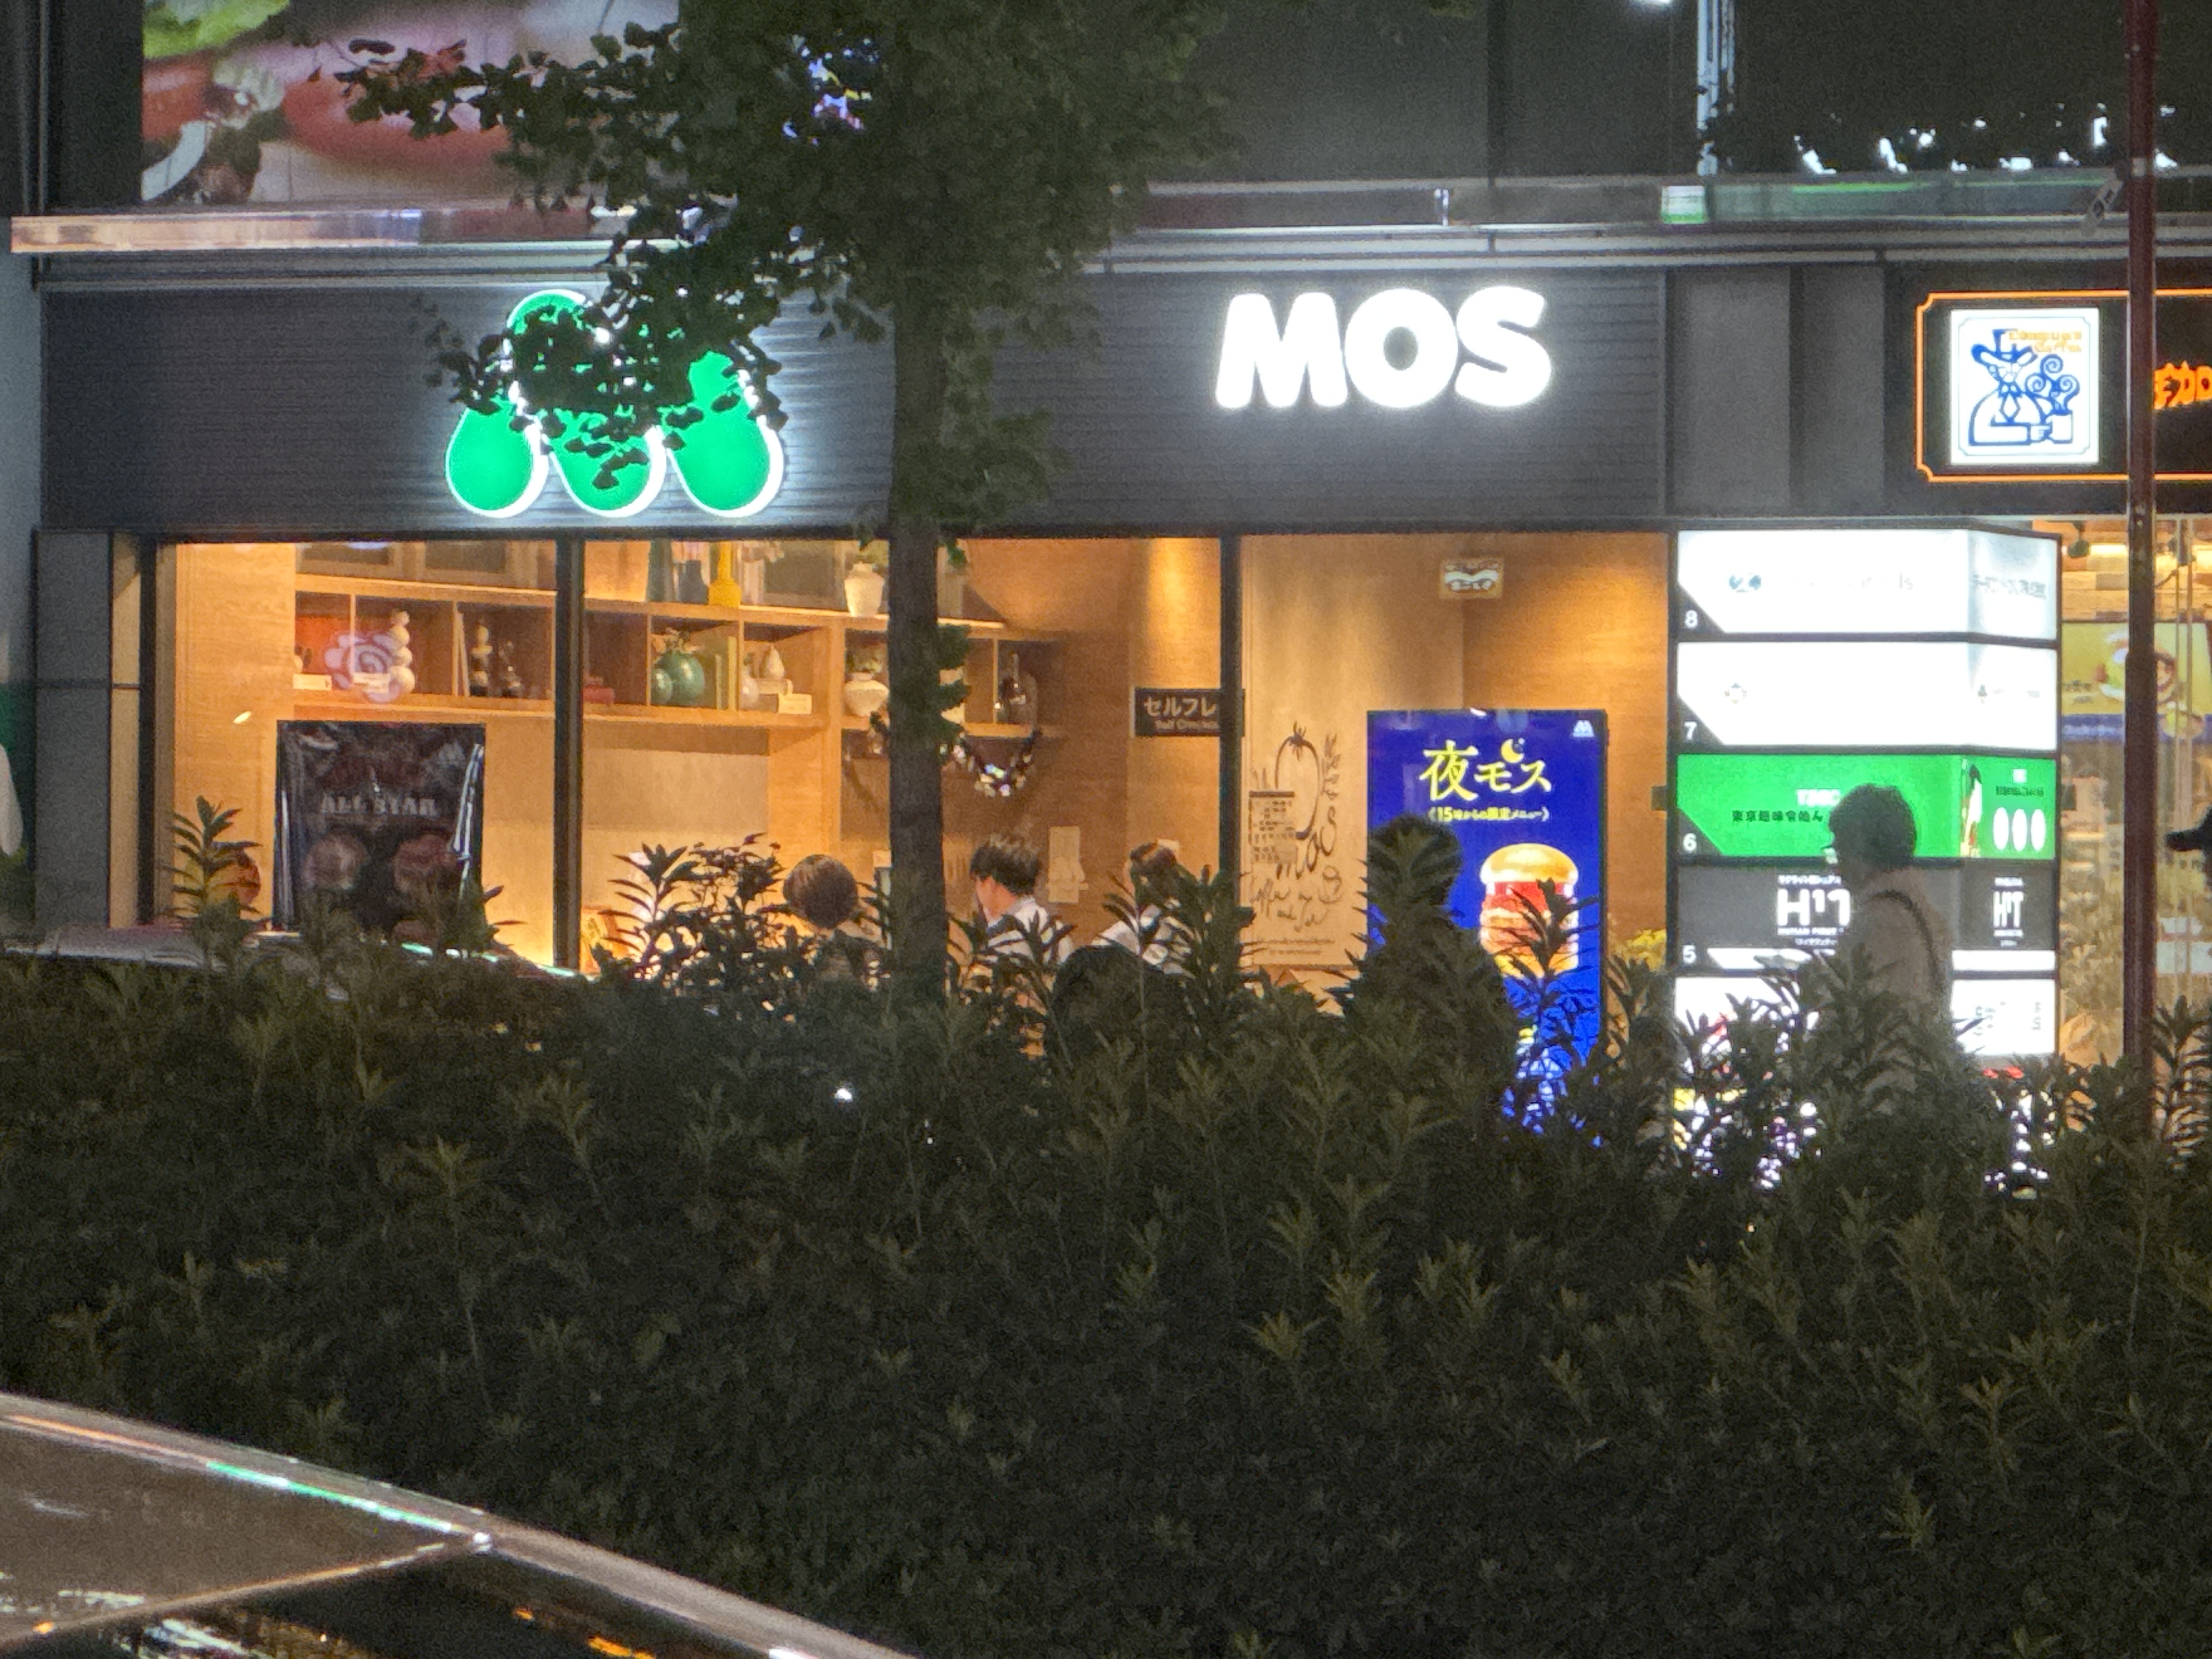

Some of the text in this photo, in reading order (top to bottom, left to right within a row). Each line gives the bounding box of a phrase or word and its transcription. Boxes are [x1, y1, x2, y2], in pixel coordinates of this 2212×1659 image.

[1215, 285, 1551, 408] MOS
[1684, 610, 1698, 629] 8
[1144, 696, 1217, 716] セルフレ
[1684, 721, 1697, 740] 7
[1419, 739, 1551, 801] 夜モス
[1682, 833, 1697, 852] 6
[1682, 945, 1697, 964] 5
